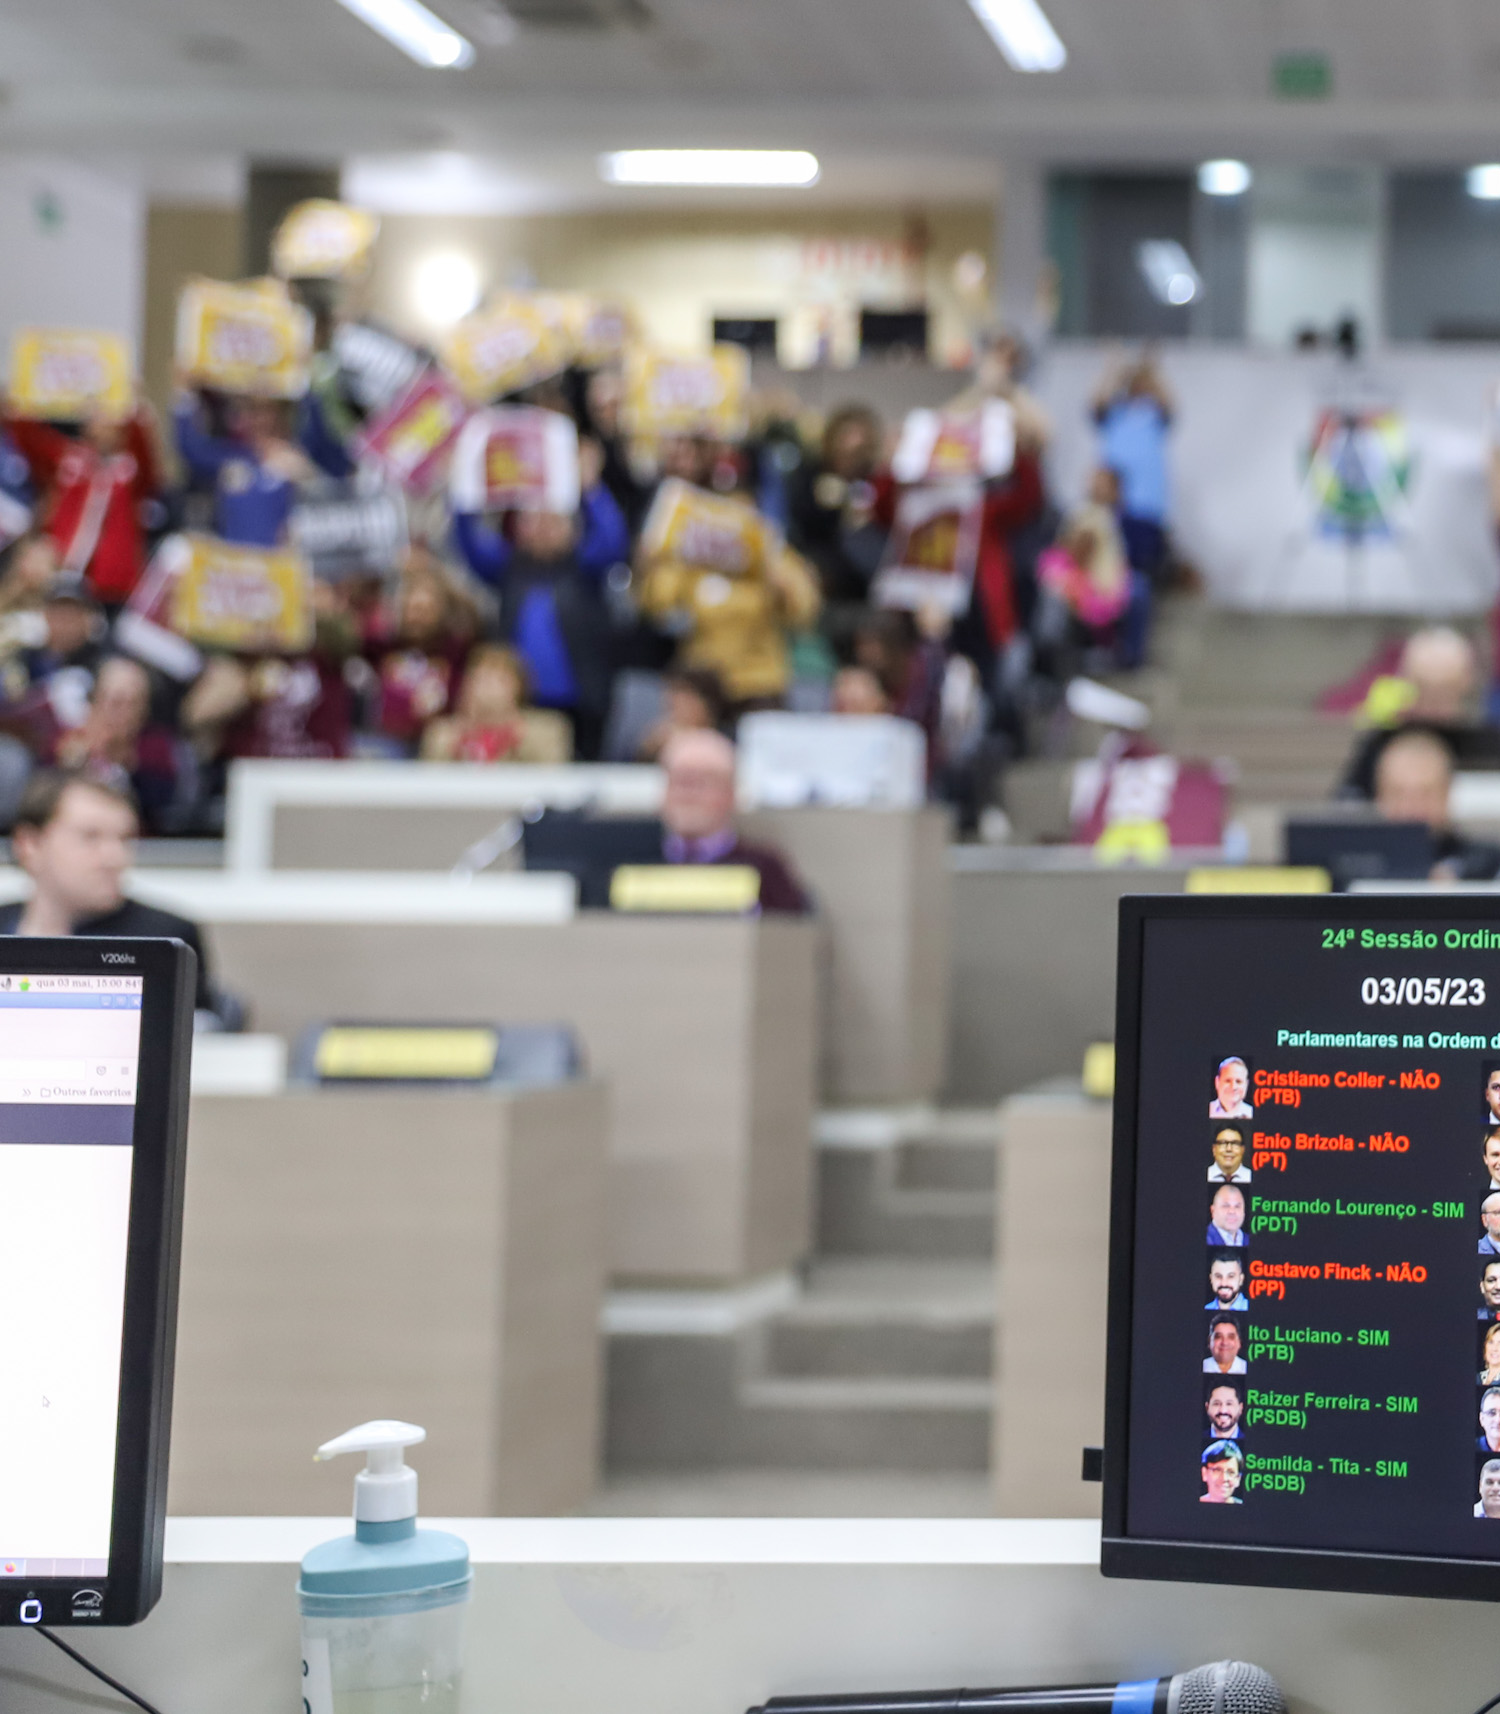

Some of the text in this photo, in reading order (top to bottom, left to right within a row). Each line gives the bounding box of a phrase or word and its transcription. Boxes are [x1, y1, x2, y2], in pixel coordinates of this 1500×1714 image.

[1361, 929, 1438, 948] Sessão
[58, 978, 70, 987] 03
[1361, 977, 1486, 1006] 03/05/23
[1277, 1030, 1398, 1048] Parlamentares
[1403, 1035, 1424, 1048] na
[1428, 1032, 1486, 1049] Ordem
[1254, 1070, 1330, 1087] Cristiano
[1334, 1071, 1385, 1088] Coller
[1400, 1069, 1440, 1089] NÃO
[53, 1087, 132, 1097] Outros favoritos
[1254, 1088, 1301, 1107] (PTB)
[1253, 1132, 1291, 1150] Enio
[1295, 1133, 1354, 1151] Brizola
[1369, 1132, 1409, 1152] NÃO
[1252, 1152, 1287, 1172] (PT)
[1252, 1197, 1331, 1215] Fernando
[1336, 1199, 1416, 1219] Lourenço
[1432, 1202, 1464, 1218] SIM
[1251, 1217, 1297, 1235] (PDT)
[1250, 1261, 1320, 1279] Gustavo
[1324, 1263, 1371, 1280] Finck
[1387, 1262, 1427, 1282] NÃO
[1249, 1280, 1285, 1299] (PP)
[1249, 1326, 1270, 1342] Ito
[1275, 1327, 1342, 1344] Luciano
[1358, 1329, 1389, 1346] SIM
[1248, 1345, 1294, 1364] (PTB)
[1247, 1390, 1299, 1407] Raizer
[1305, 1392, 1370, 1410] Ferreira
[1386, 1396, 1417, 1412] SIM
[1247, 1408, 1306, 1429] (PSDB)
[1245, 1453, 1312, 1472] Semilda
[1329, 1458, 1359, 1474] Tita
[1376, 1461, 1407, 1477] SIM
[1244, 1473, 1305, 1494] (PSDB)
